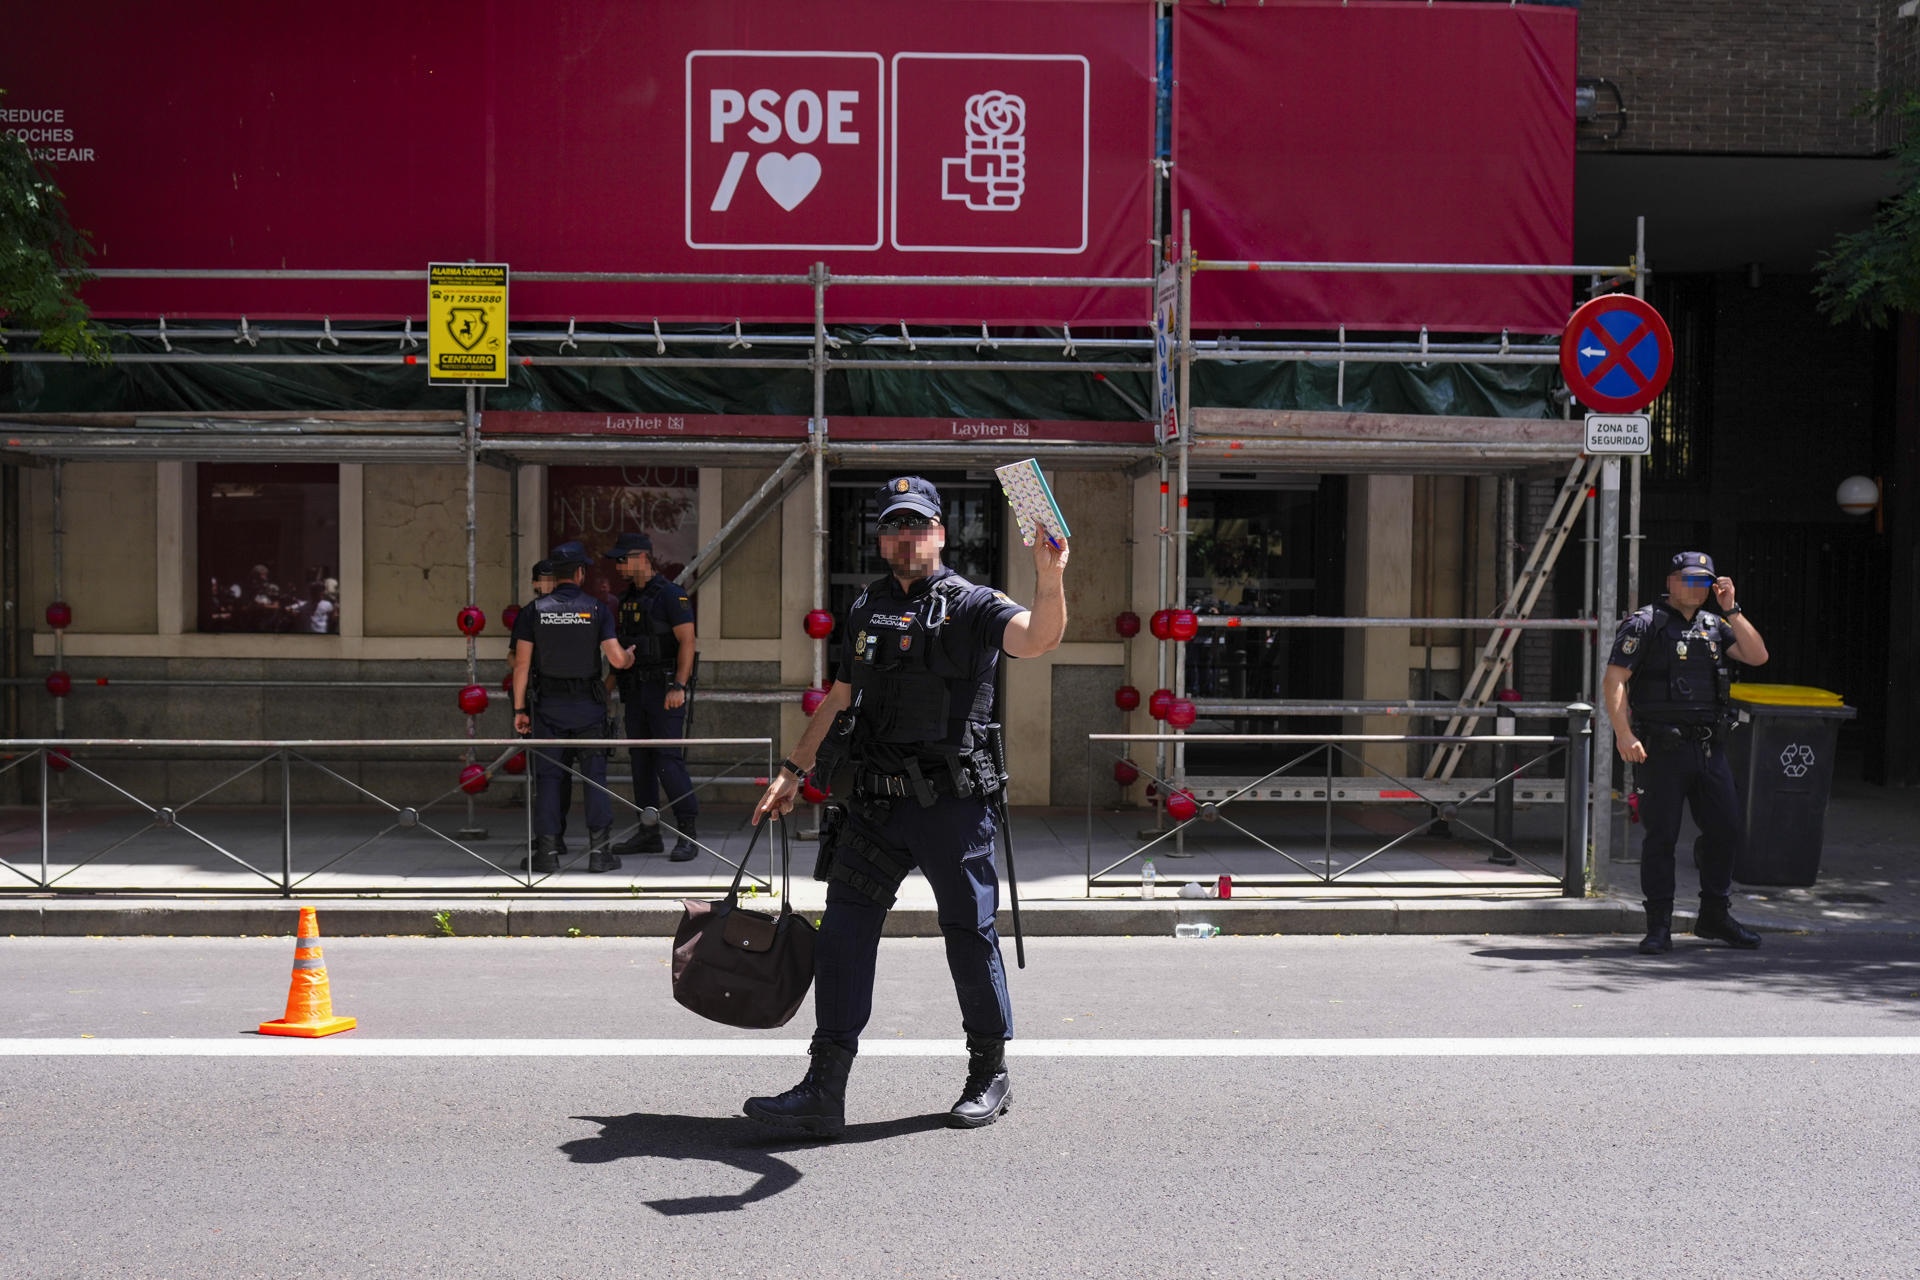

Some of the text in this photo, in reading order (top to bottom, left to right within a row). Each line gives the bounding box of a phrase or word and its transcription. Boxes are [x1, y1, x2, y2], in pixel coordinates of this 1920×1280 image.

[0, 109, 64, 123] REDUCE
[710, 89, 859, 144] PSOE
[431, 267, 504, 277] ALARMA CONECTADA
[443, 295, 502, 303] 91 7853880
[441, 355, 493, 363] CENTAURO
[606, 416, 662, 431] Layher
[952, 422, 1007, 437] Layher
[1597, 424, 1639, 433] ZONA DE
[1591, 436, 1644, 445] SEGURIDAD
[869, 619, 907, 627] NACIONAL
